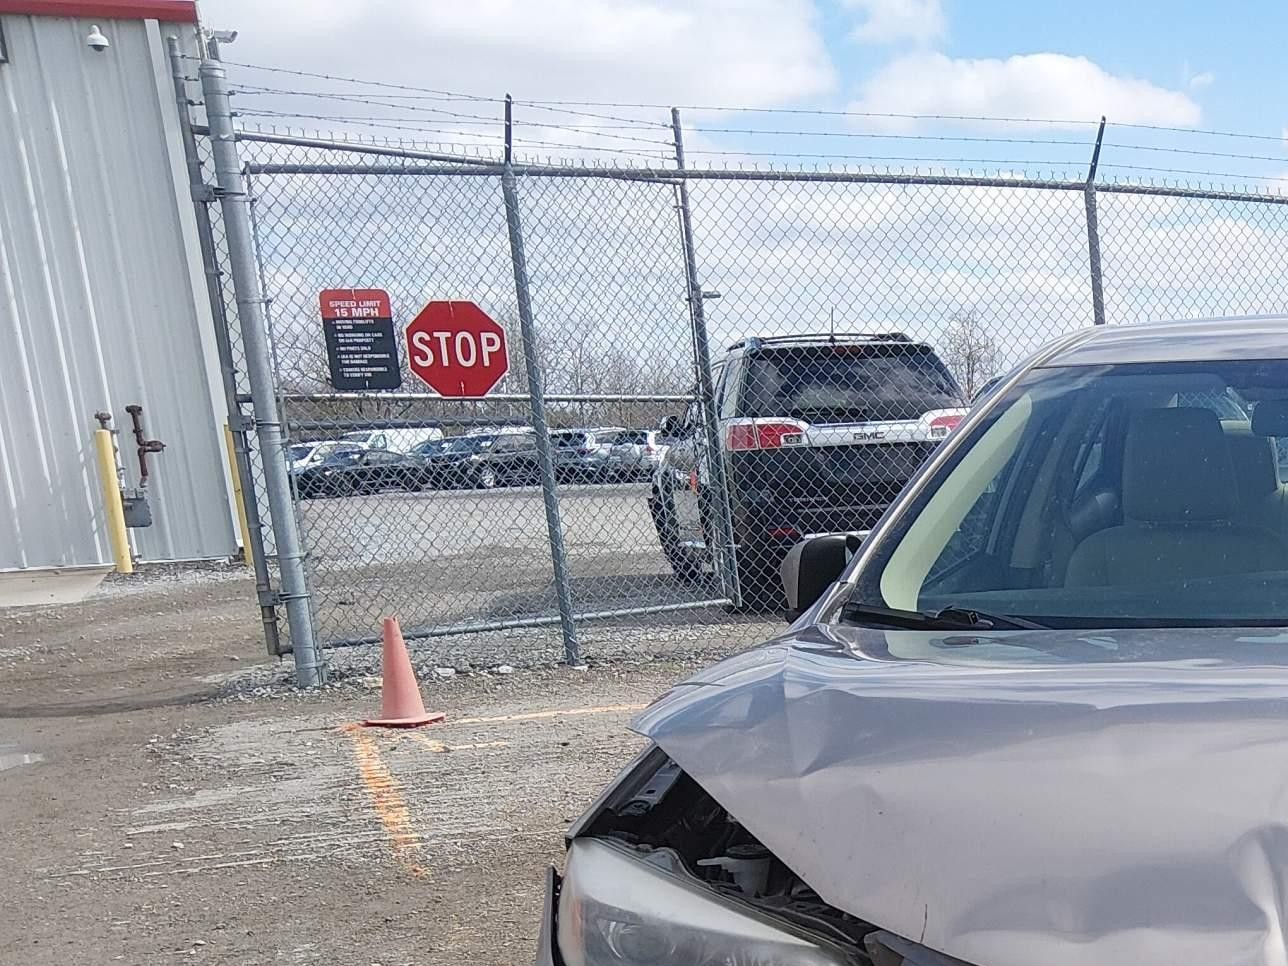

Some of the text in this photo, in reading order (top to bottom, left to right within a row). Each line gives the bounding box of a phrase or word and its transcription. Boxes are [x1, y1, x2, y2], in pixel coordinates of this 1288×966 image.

[334, 308, 379, 317] 15 MPH
[412, 331, 500, 368] STOP
[853, 431, 885, 440] GMC
